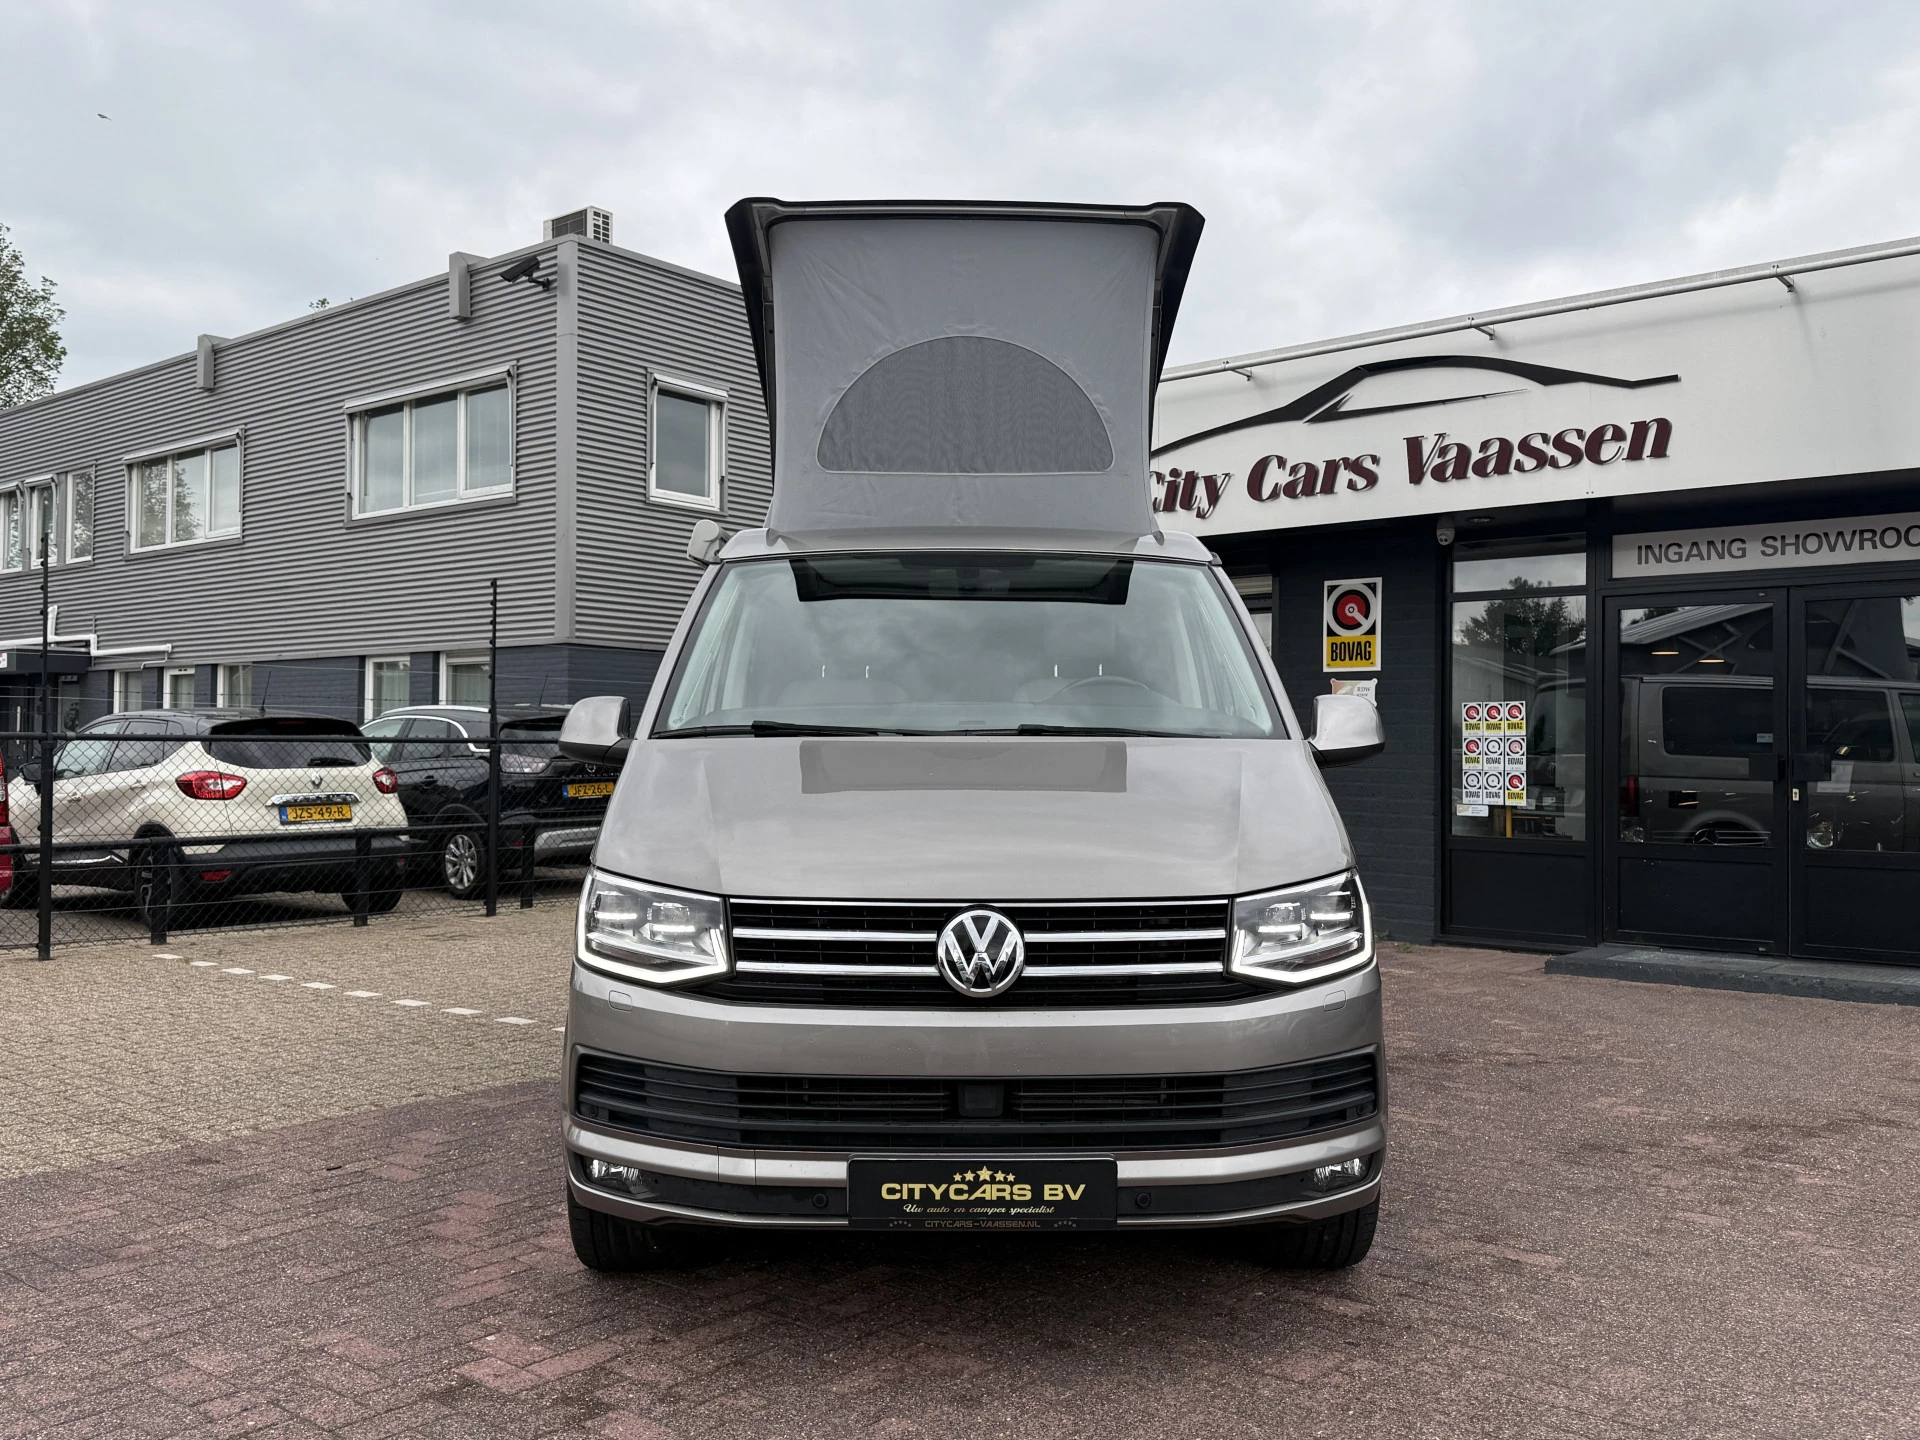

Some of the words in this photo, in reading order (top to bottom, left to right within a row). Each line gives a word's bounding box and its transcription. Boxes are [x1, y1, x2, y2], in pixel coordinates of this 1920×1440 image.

[1247, 453, 1379, 502] Cars
[1403, 417, 1672, 484] Vaassen
[1637, 537, 1747, 565] INGANG
[1330, 640, 1372, 662] BOVAG
[1465, 756, 1480, 764] BOVAG
[1485, 757, 1501, 765] BOVAG
[1508, 757, 1523, 765] BOVAG
[1508, 791, 1524, 800] BOVAG
[292, 807, 345, 819] JZS-49-R
[881, 1183, 1032, 1200] CITYCARS
[1043, 1184, 1086, 1200] BV
[903, 1204, 924, 1213] Uw
[969, 1207, 1006, 1215] camper
[1009, 1205, 1055, 1215] specialist
[925, 1220, 1040, 1228] CITYCARS-VAASSEN.NL
